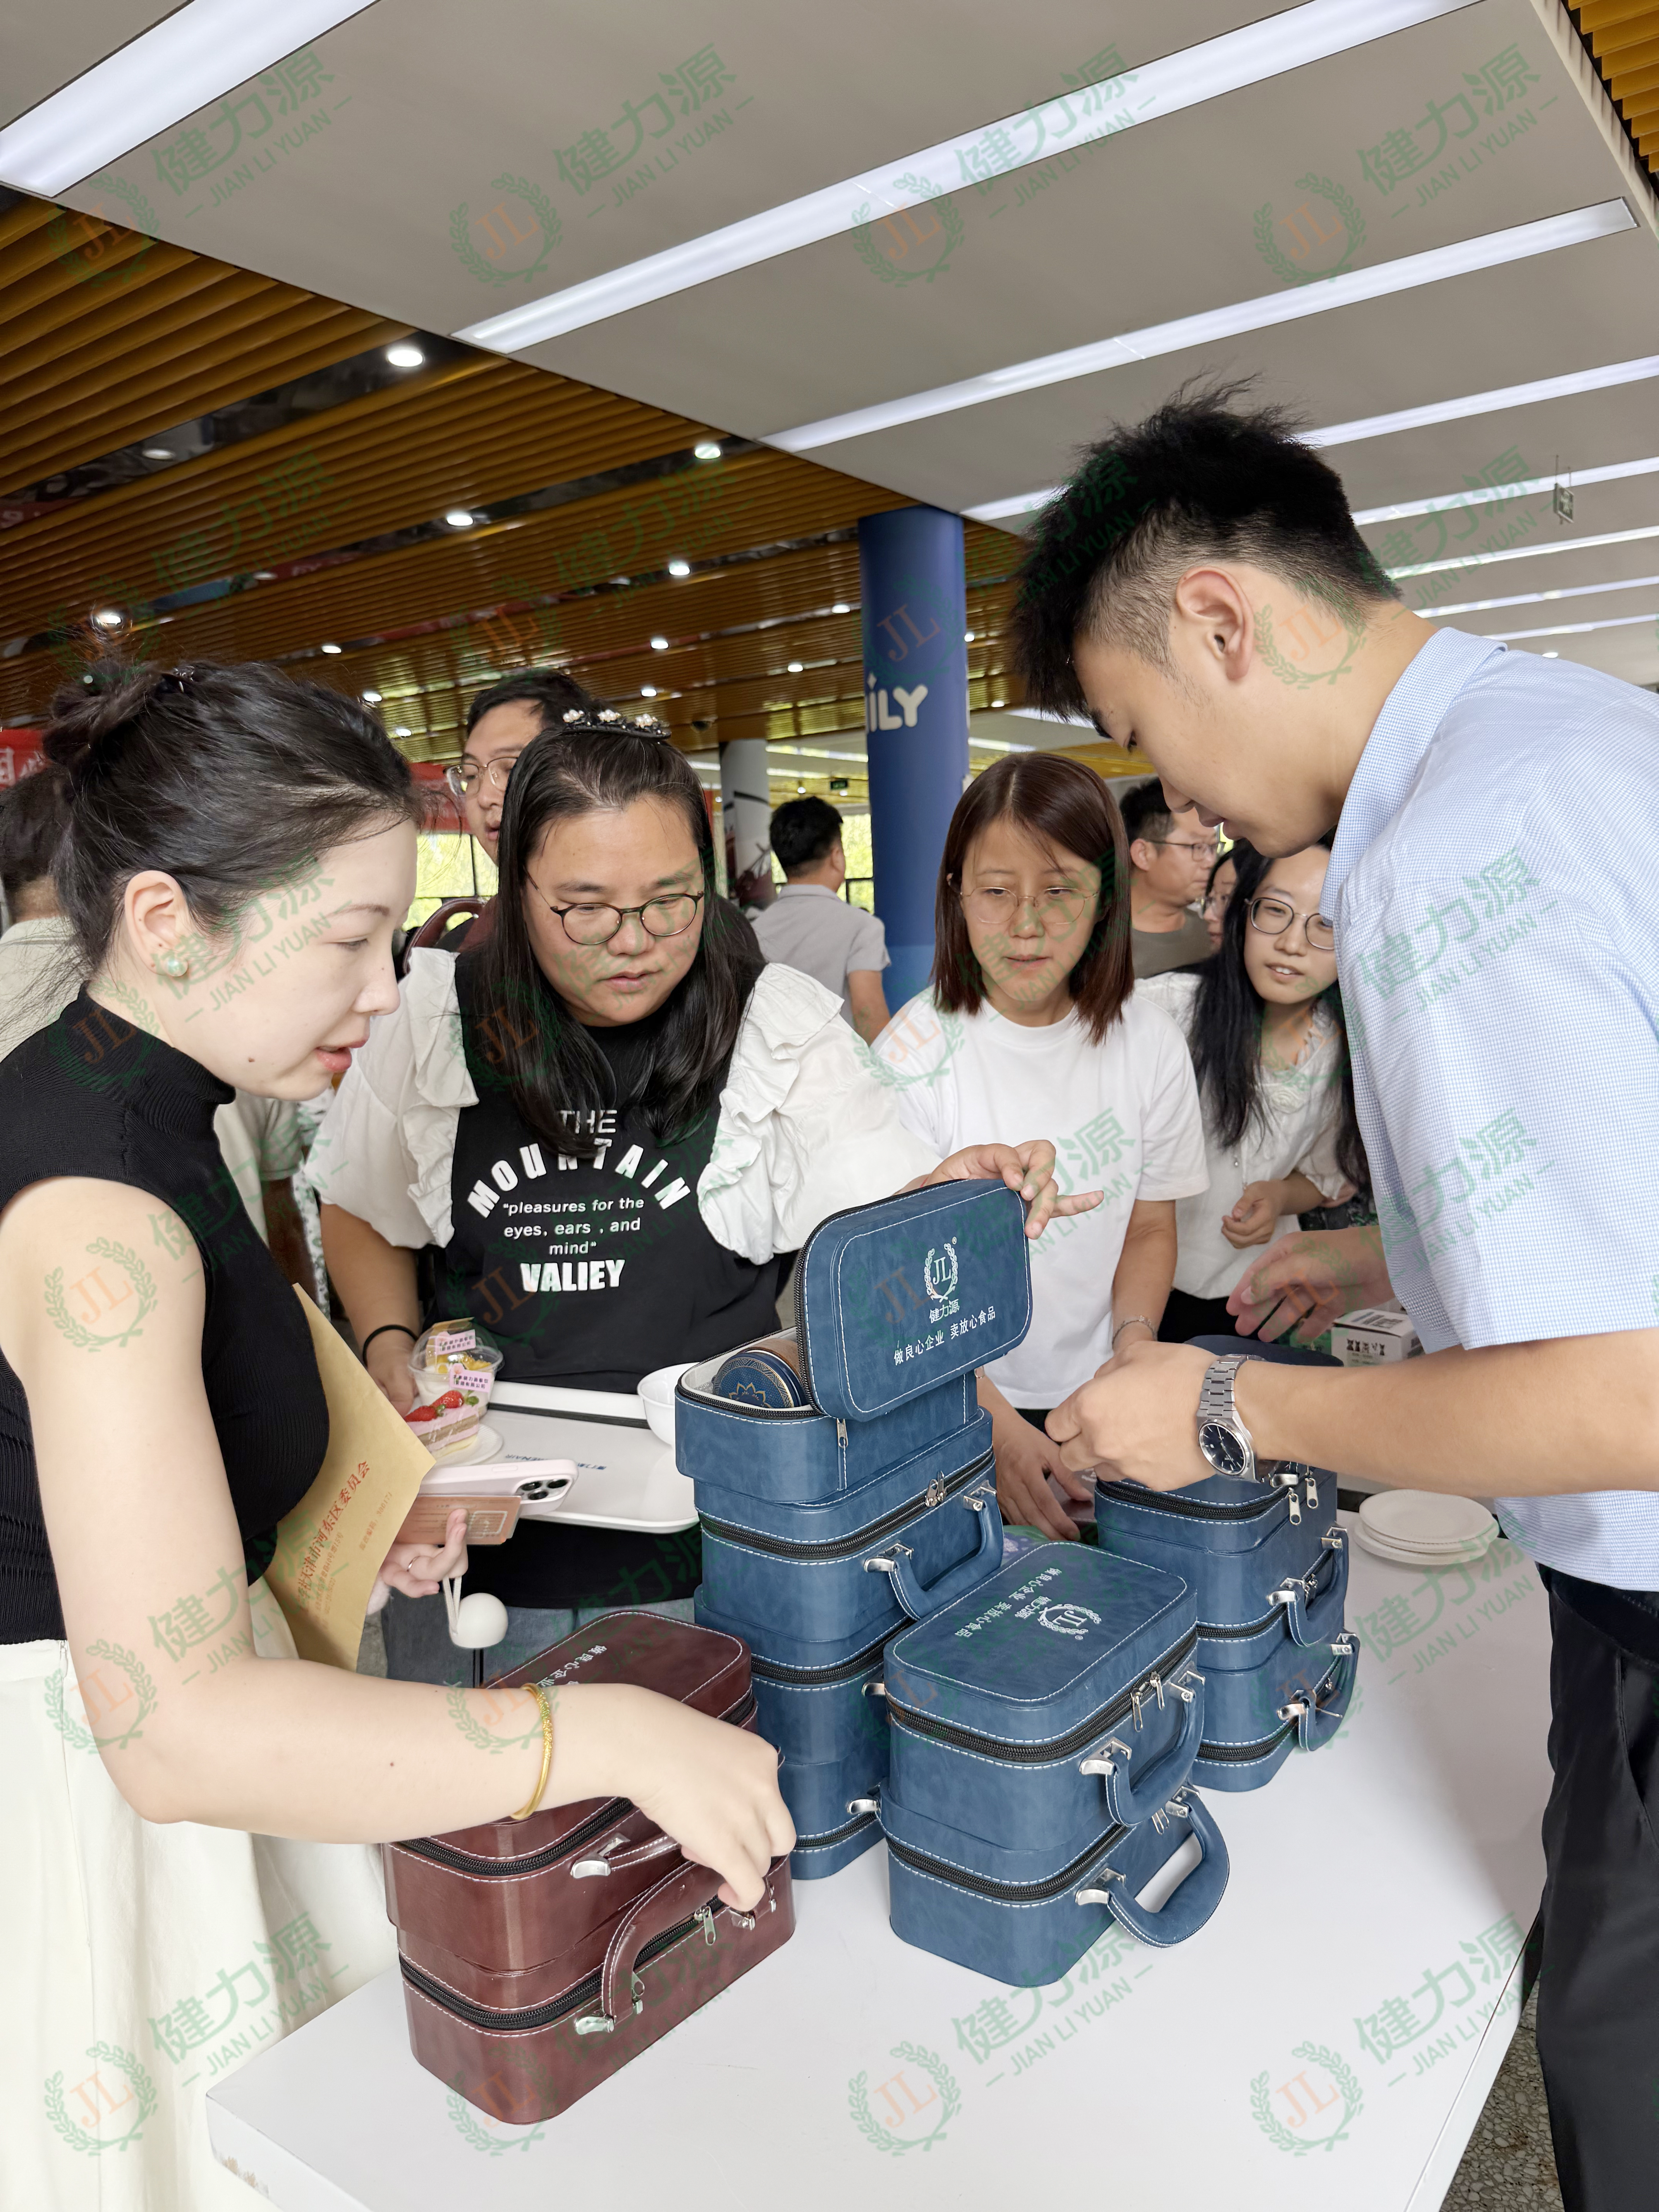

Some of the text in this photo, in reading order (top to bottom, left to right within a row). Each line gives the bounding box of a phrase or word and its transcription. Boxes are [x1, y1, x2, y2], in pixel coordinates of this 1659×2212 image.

[559, 1110, 617, 1133] THE
[592, 1199, 613, 1211] for
[620, 1198, 644, 1209] the
[504, 1225, 547, 1239] eyes,
[555, 1223, 591, 1235] ears
[610, 1218, 641, 1233] and
[933, 1257, 951, 1285] JL
[929, 1298, 960, 1324] 健力源
[894, 1305, 995, 1365] 做良心企业 卖放心食品
[955, 1567, 1062, 1638] 做良心企业 卖放心食品
[1015, 1595, 1052, 1619] 健力源
[1053, 1610, 1087, 1627] JL
